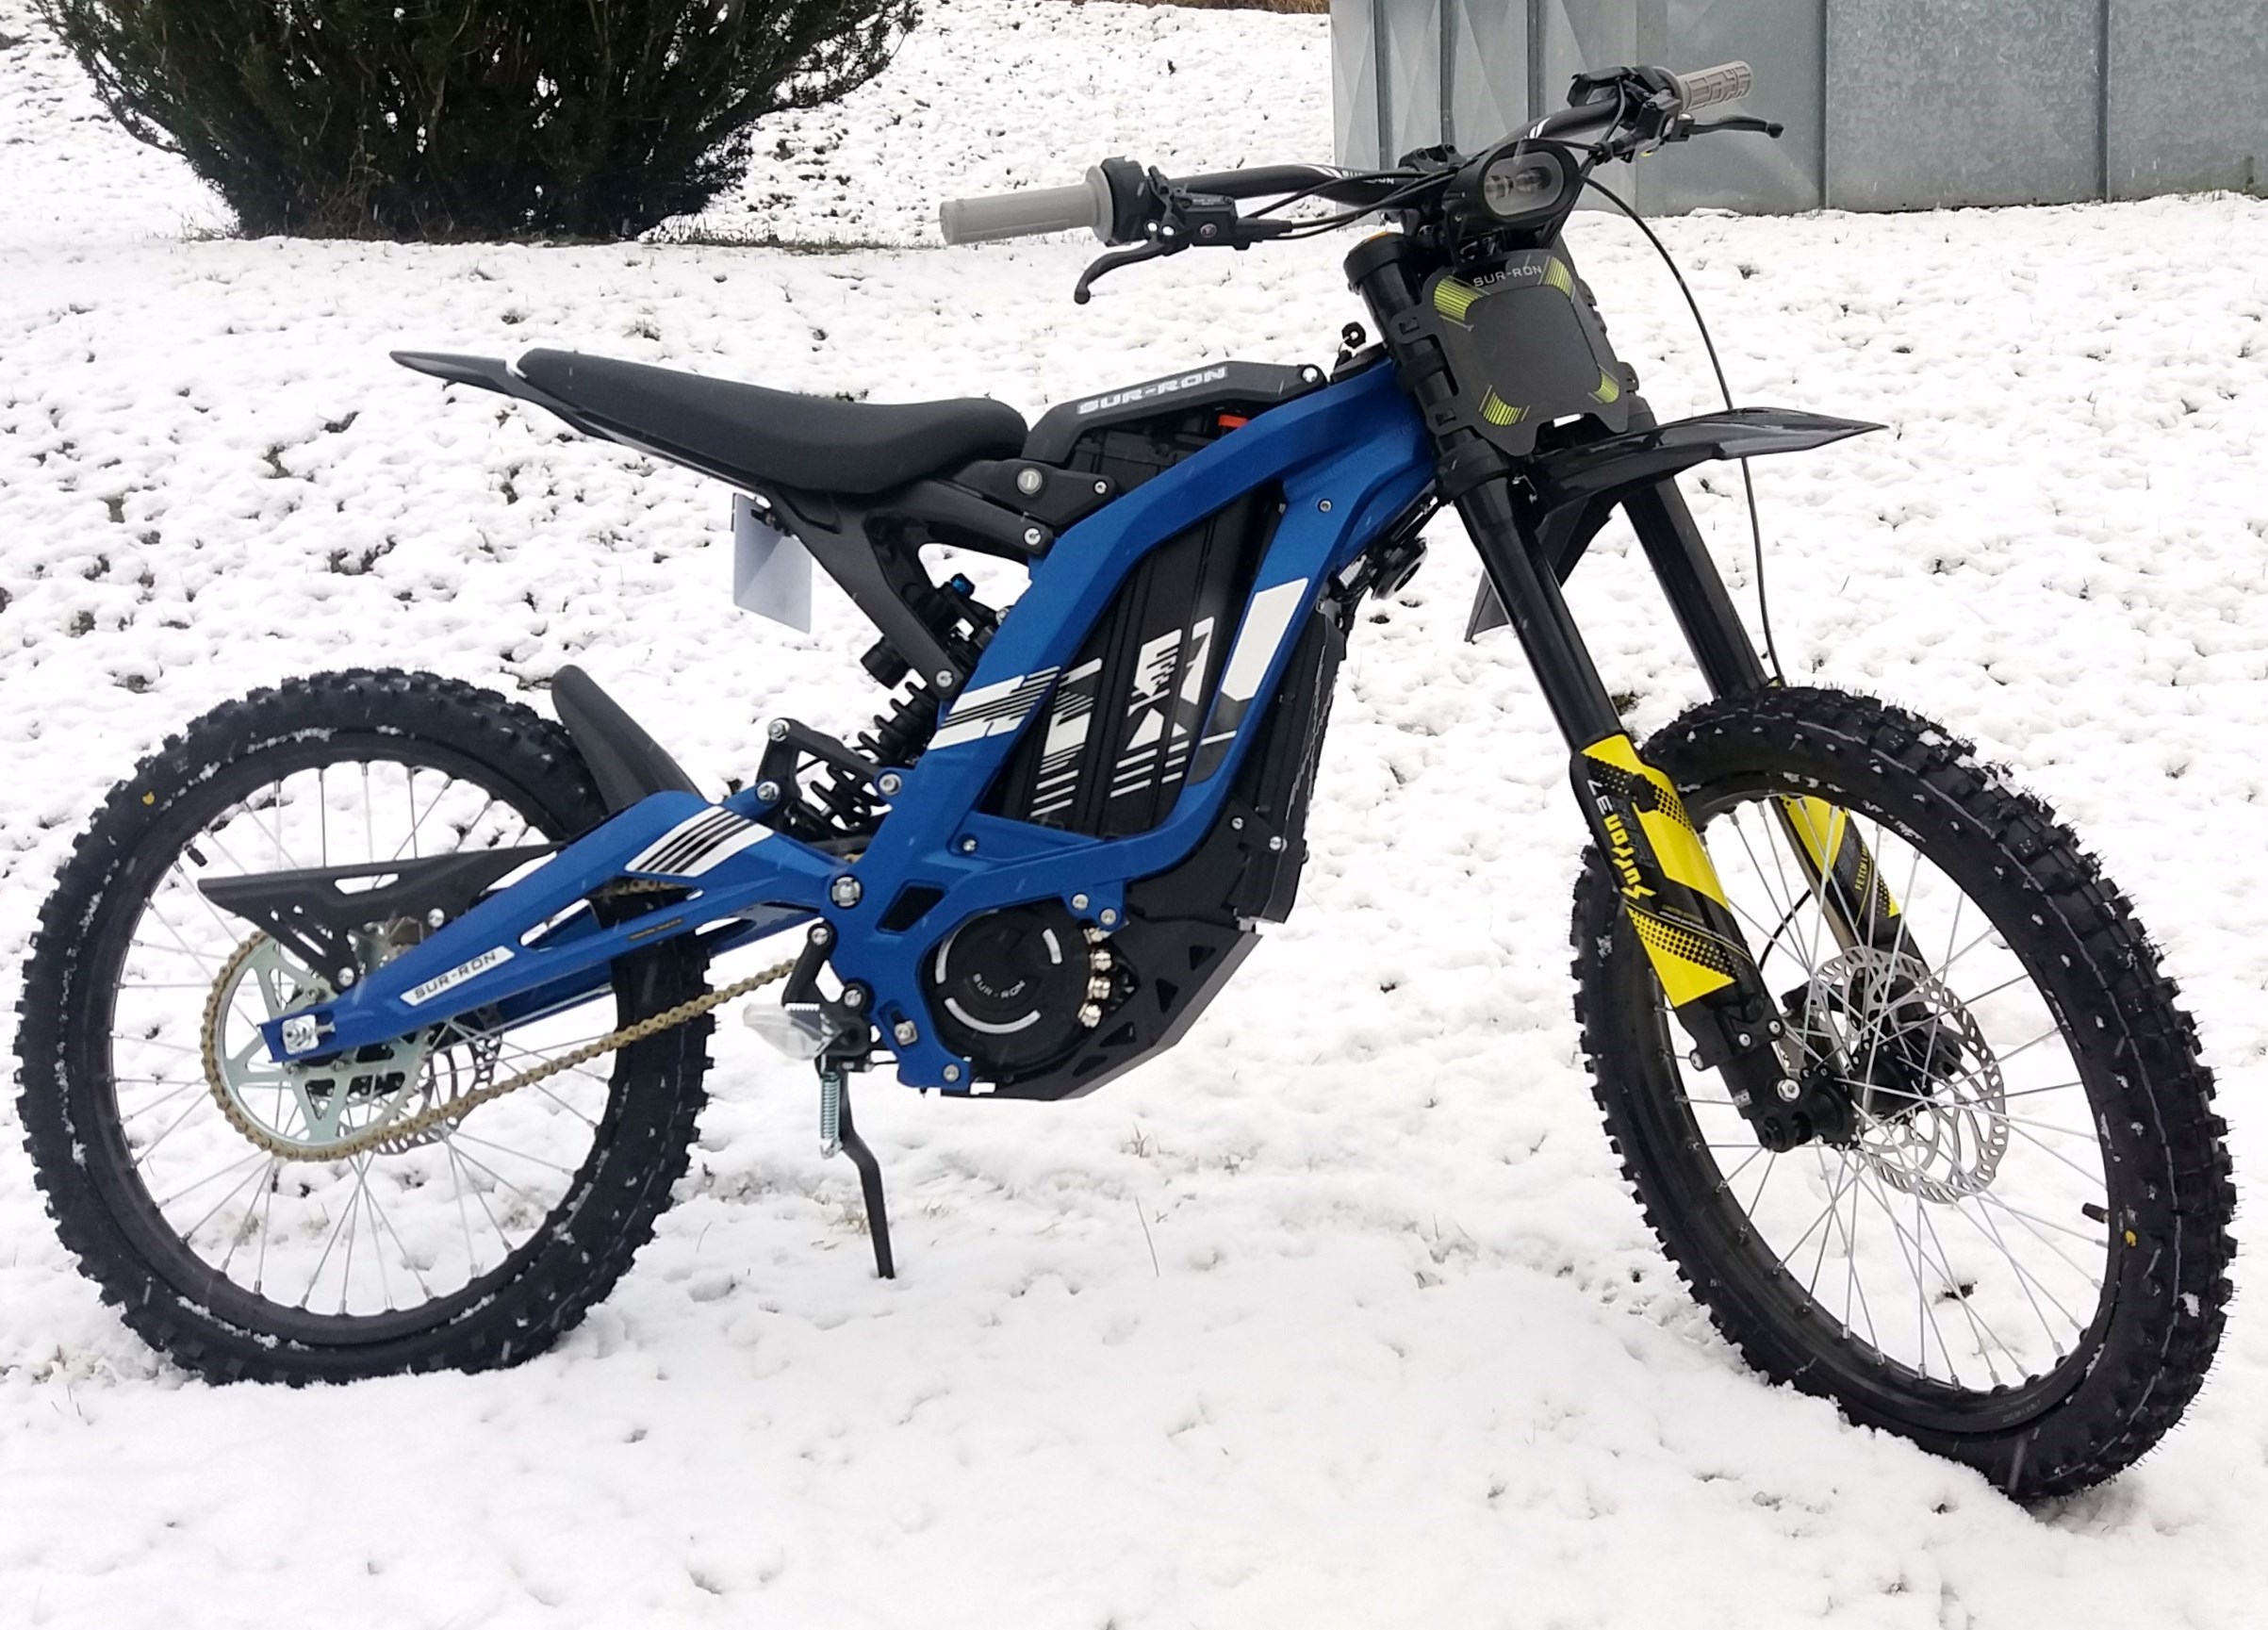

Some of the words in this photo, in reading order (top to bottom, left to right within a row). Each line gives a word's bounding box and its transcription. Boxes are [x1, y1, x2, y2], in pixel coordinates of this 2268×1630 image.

[1472, 265, 1542, 287] SUR-RON
[1077, 366, 1228, 415] SUR-RON
[415, 951, 498, 999] SUR-RON
